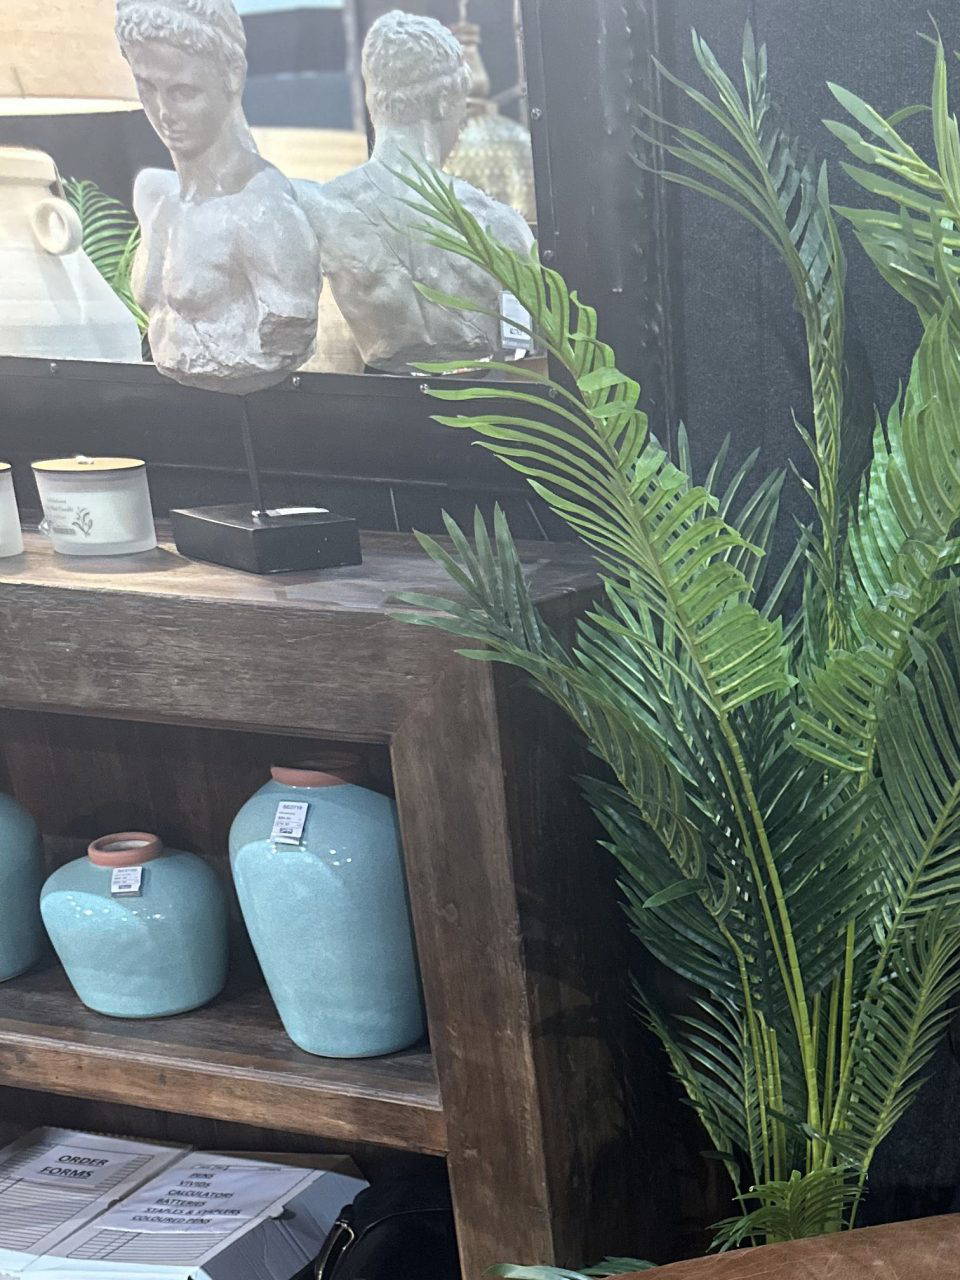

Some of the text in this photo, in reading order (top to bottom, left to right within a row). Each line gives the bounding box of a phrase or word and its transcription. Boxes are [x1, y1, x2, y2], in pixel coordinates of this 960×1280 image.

[57, 1155, 109, 1167] ORDER
[40, 1166, 94, 1178] FORMS
[155, 1198, 208, 1207] BATTERIES
[144, 1207, 184, 1215] STAPLES
[131, 1215, 186, 1224] COLOURED
